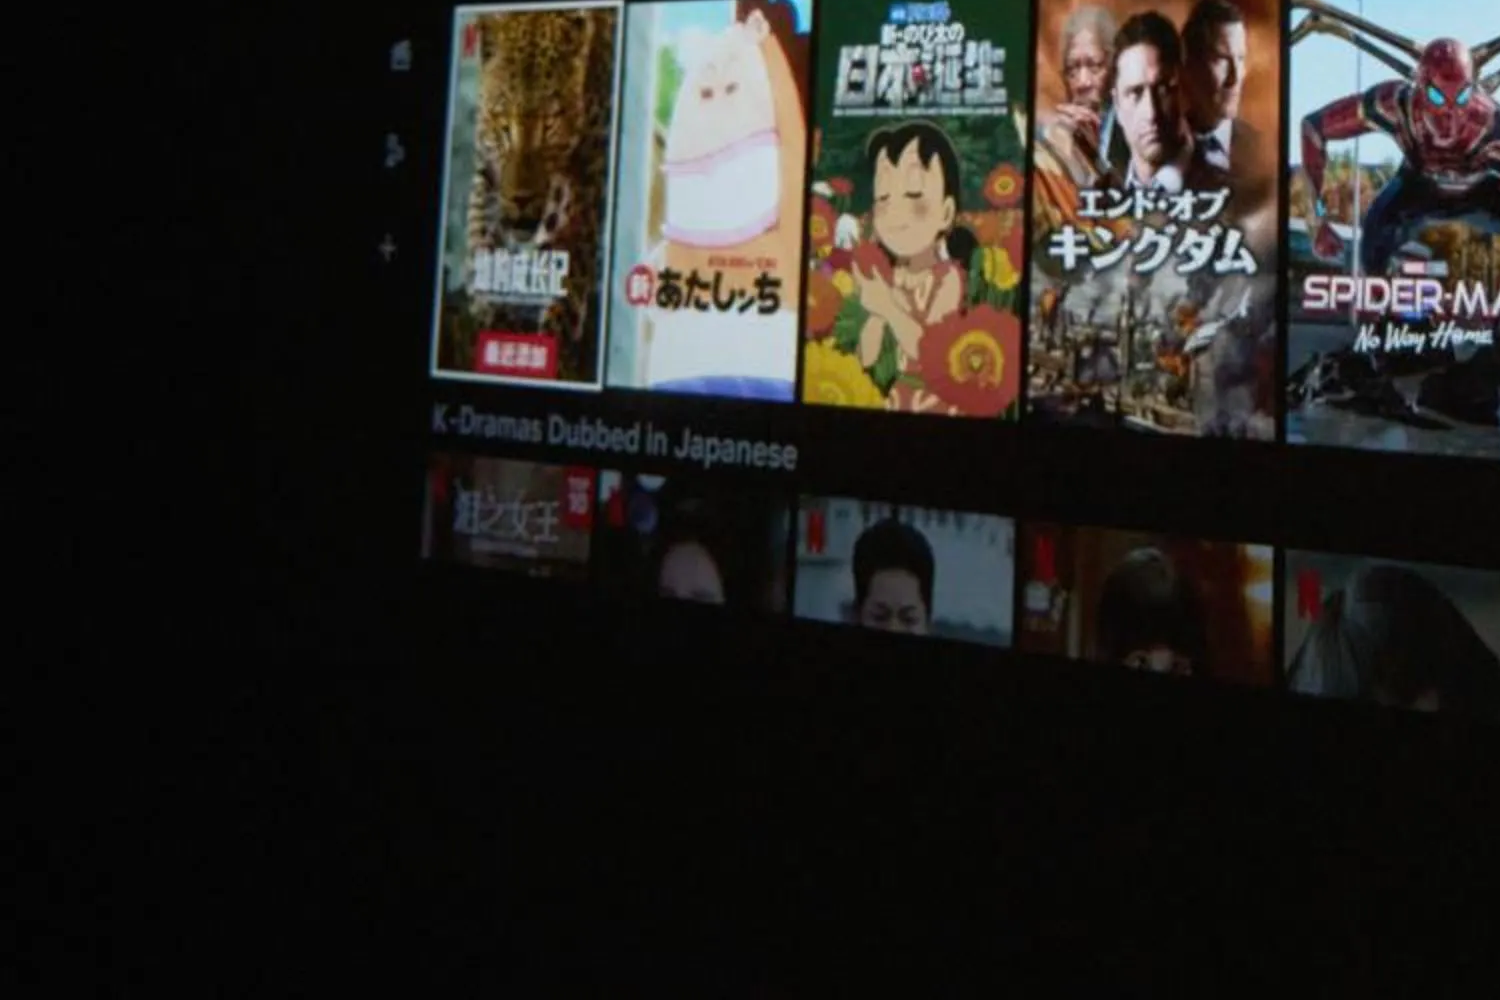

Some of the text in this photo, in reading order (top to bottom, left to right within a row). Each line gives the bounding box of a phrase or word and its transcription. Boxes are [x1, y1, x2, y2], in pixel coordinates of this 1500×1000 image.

[1048, 223, 1259, 275] キングダム
[1354, 323, 1381, 353] No
[1383, 322, 1427, 354] Way
[432, 402, 543, 443] K-Dramas
[547, 414, 641, 454] Dubbed
[674, 429, 799, 471] Japanese
